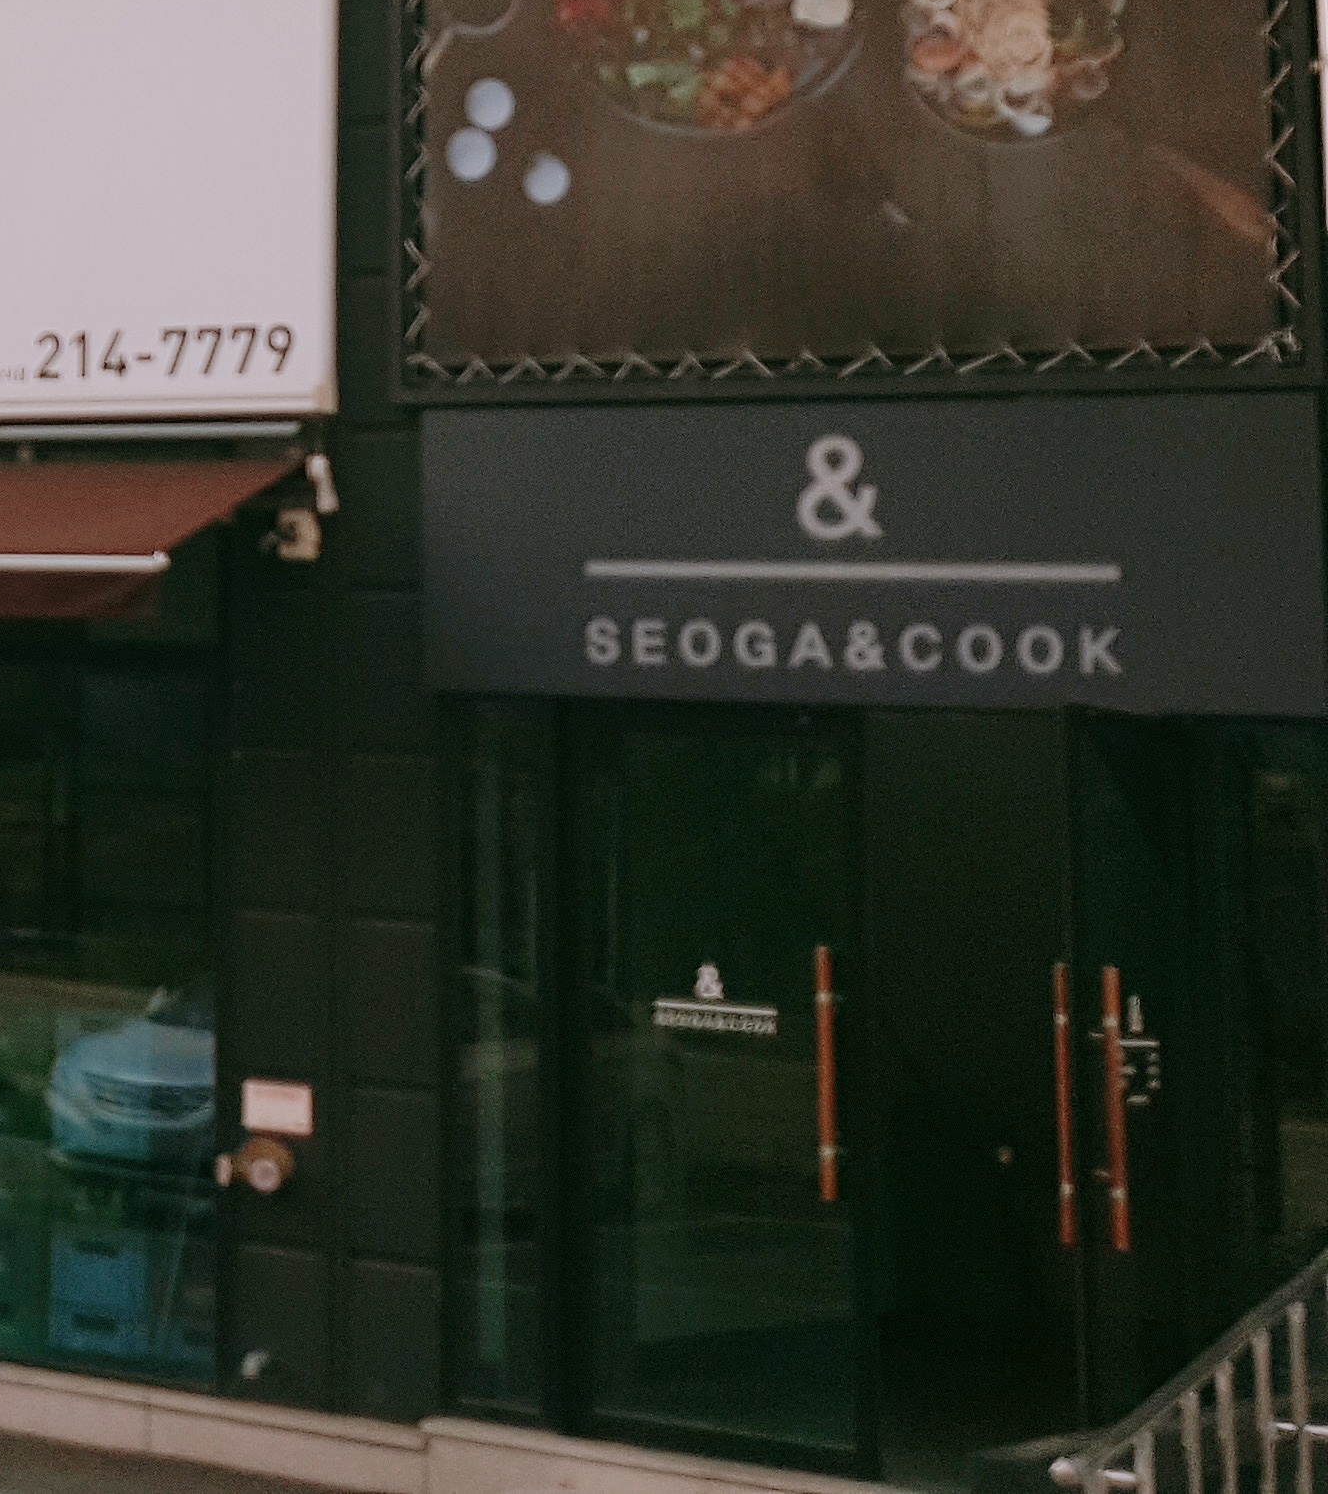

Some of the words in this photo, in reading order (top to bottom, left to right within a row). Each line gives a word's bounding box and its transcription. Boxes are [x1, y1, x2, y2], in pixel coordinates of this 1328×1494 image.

[33, 323, 294, 380] 214-7779
[796, 433, 884, 541] &
[584, 616, 1123, 675] SEOGA&COOK
